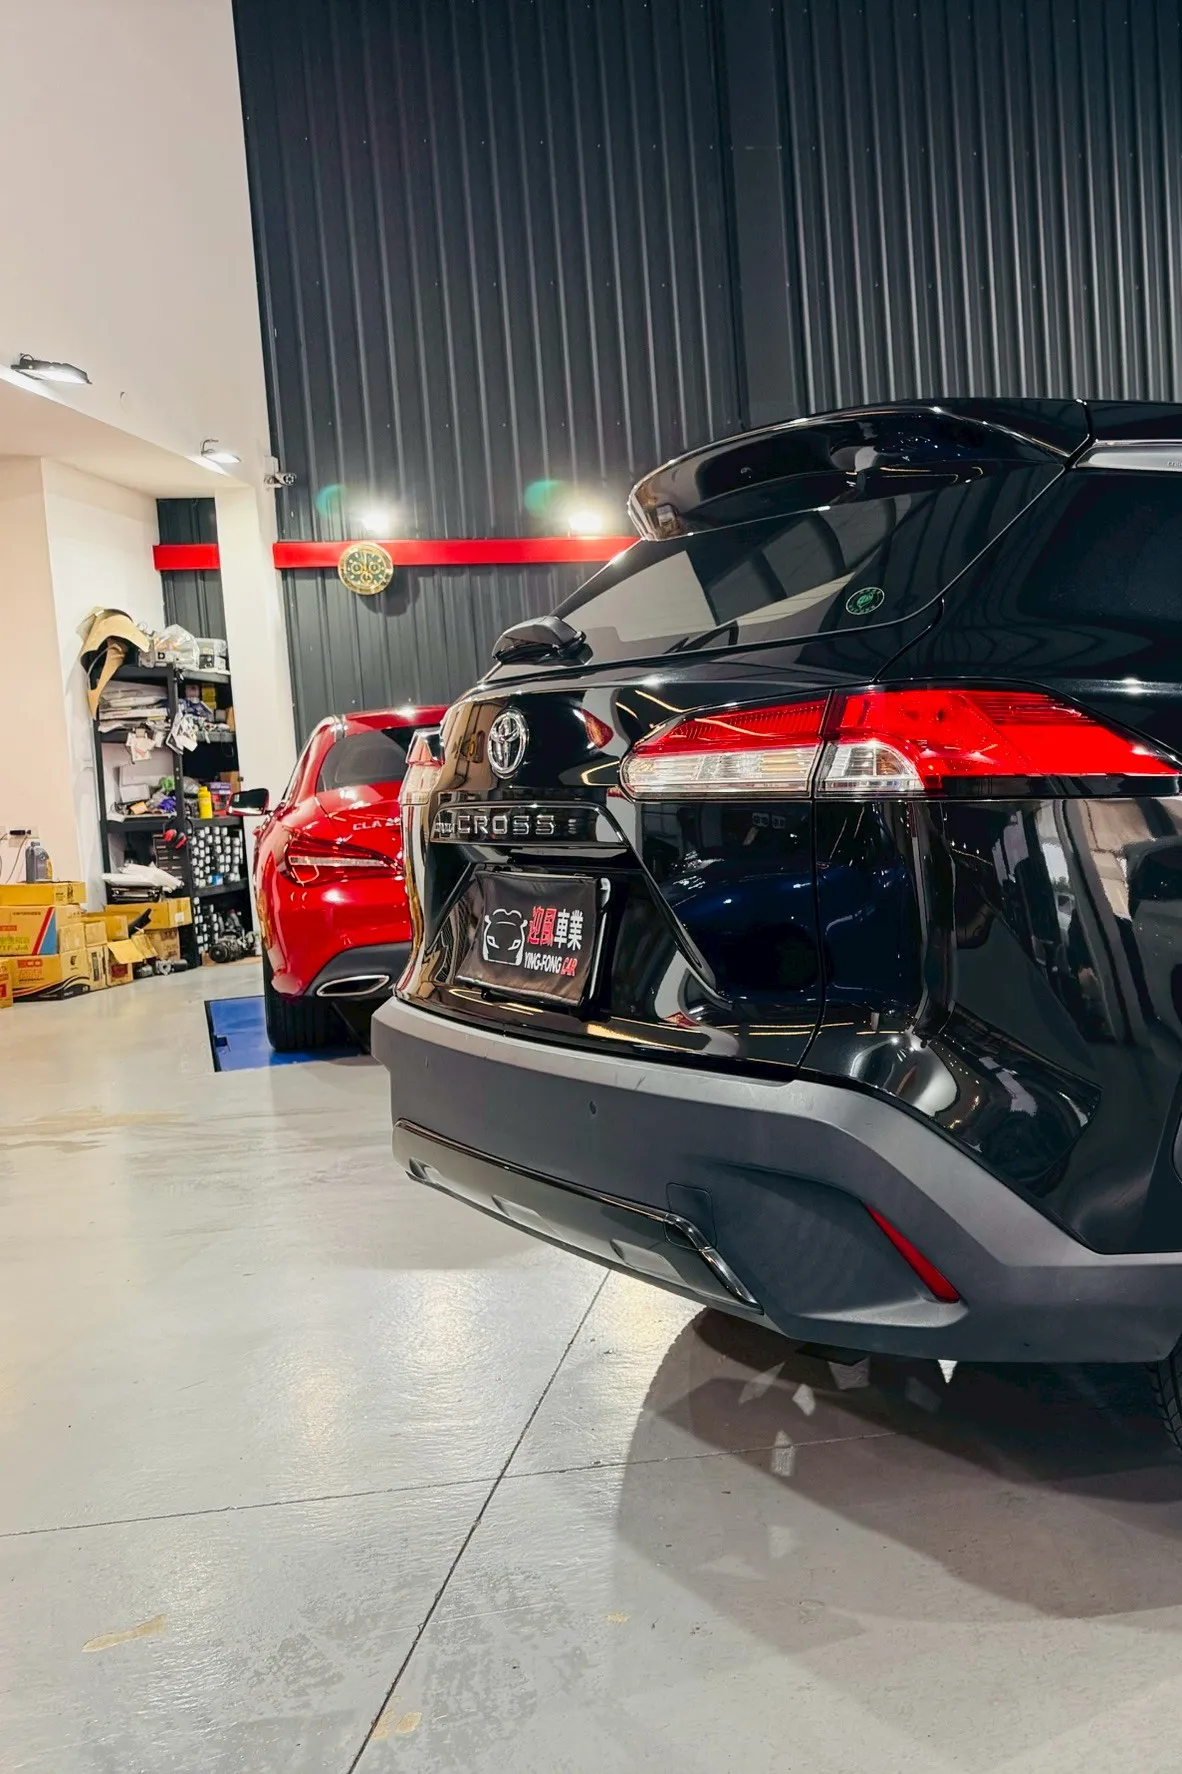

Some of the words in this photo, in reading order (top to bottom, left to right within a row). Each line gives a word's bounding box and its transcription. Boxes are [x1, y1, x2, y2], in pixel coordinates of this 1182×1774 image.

[352, 820, 382, 831] CLA
[457, 814, 555, 836] CROSS
[524, 951, 562, 974] YING-FONG
[560, 957, 578, 977] CAR
